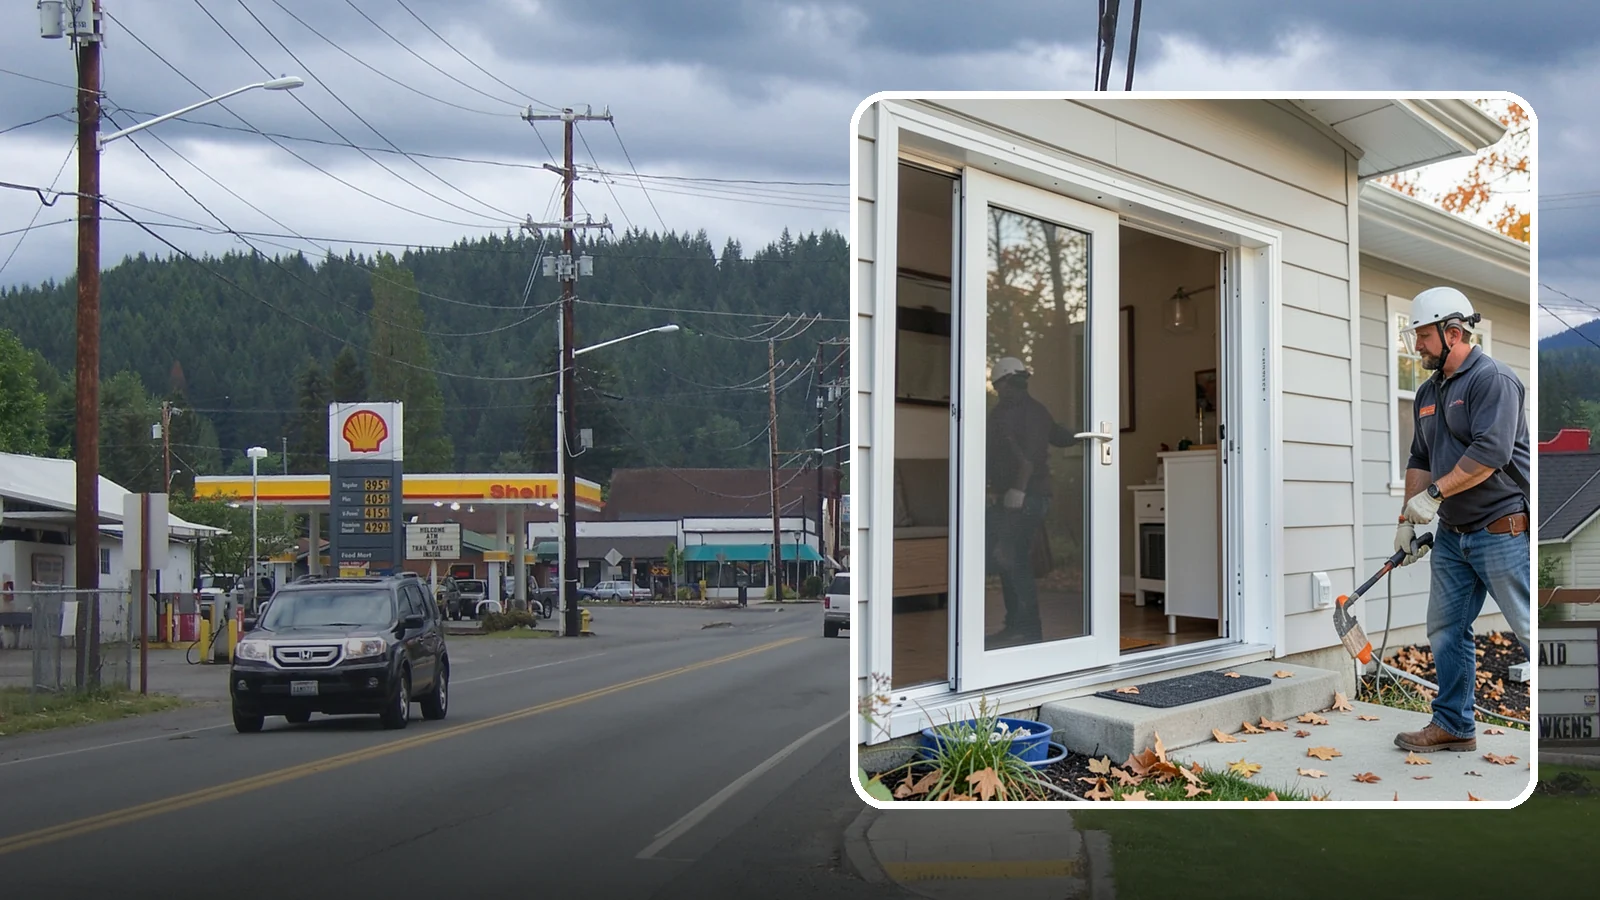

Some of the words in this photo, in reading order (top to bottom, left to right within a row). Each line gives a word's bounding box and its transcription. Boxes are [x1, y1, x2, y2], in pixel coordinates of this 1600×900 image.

[366, 479, 383, 490] 395
[490, 484, 547, 499] Shell
[366, 493, 383, 504] 405
[366, 508, 383, 518] 415
[366, 522, 383, 532] 429
[1539, 643, 1566, 665] AID
